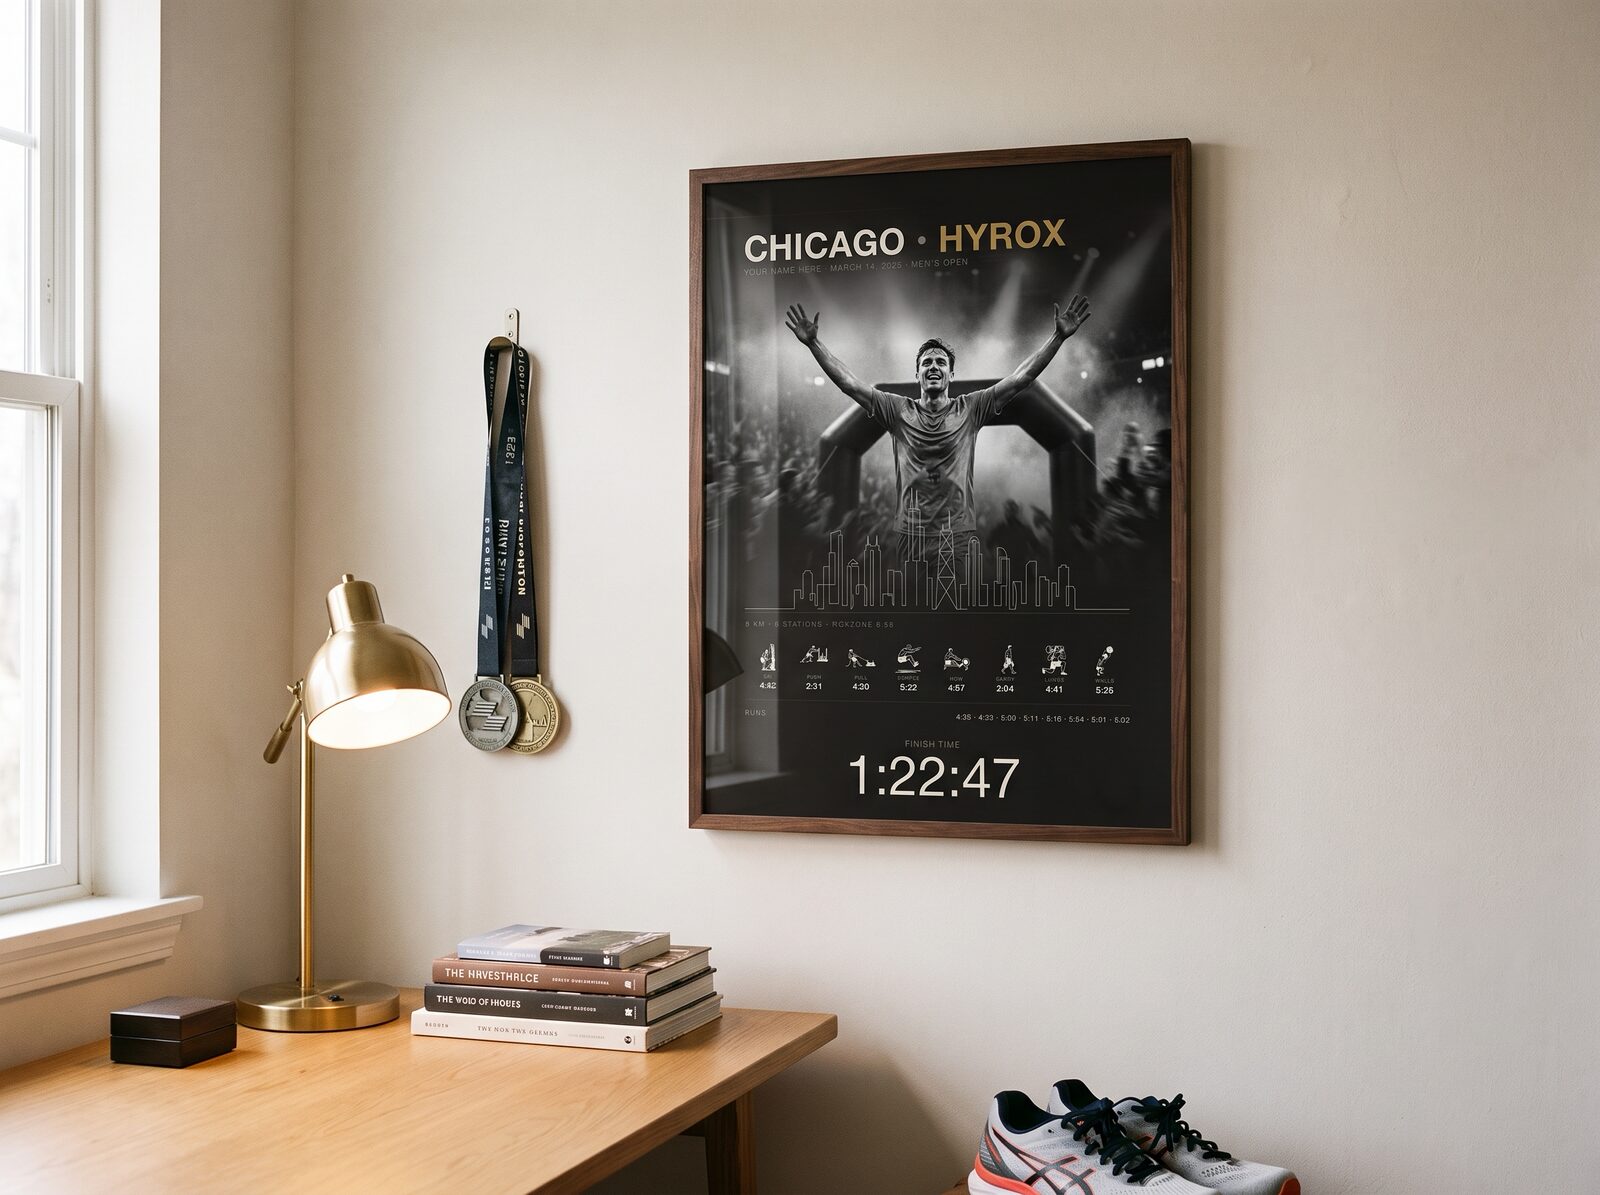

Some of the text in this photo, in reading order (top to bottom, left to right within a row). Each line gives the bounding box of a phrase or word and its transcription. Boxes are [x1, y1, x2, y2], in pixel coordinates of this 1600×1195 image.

[744, 218, 1066, 263] CHICAGO HYROX
[744, 258, 968, 276] YOUR NAME HERE MARCH 14, 2025 MEN'S OPEN
[782, 620, 823, 628] STATIONS
[805, 682, 822, 690] 2:31
[852, 682, 870, 691] 4:30
[899, 683, 918, 691] 5:22
[947, 684, 965, 692] 4:57
[996, 684, 1015, 693] 2:04
[1045, 685, 1063, 693] 4:41
[744, 709, 767, 717] RUNS
[1000, 714, 1017, 722] 5:00
[1091, 716, 1107, 724] 5:01
[905, 739, 960, 749] FINISH TIME
[849, 754, 1020, 799] 1:22:47
[445, 968, 465, 978] THE
[436, 995, 454, 1004] THE
[478, 998, 489, 1006] OF
